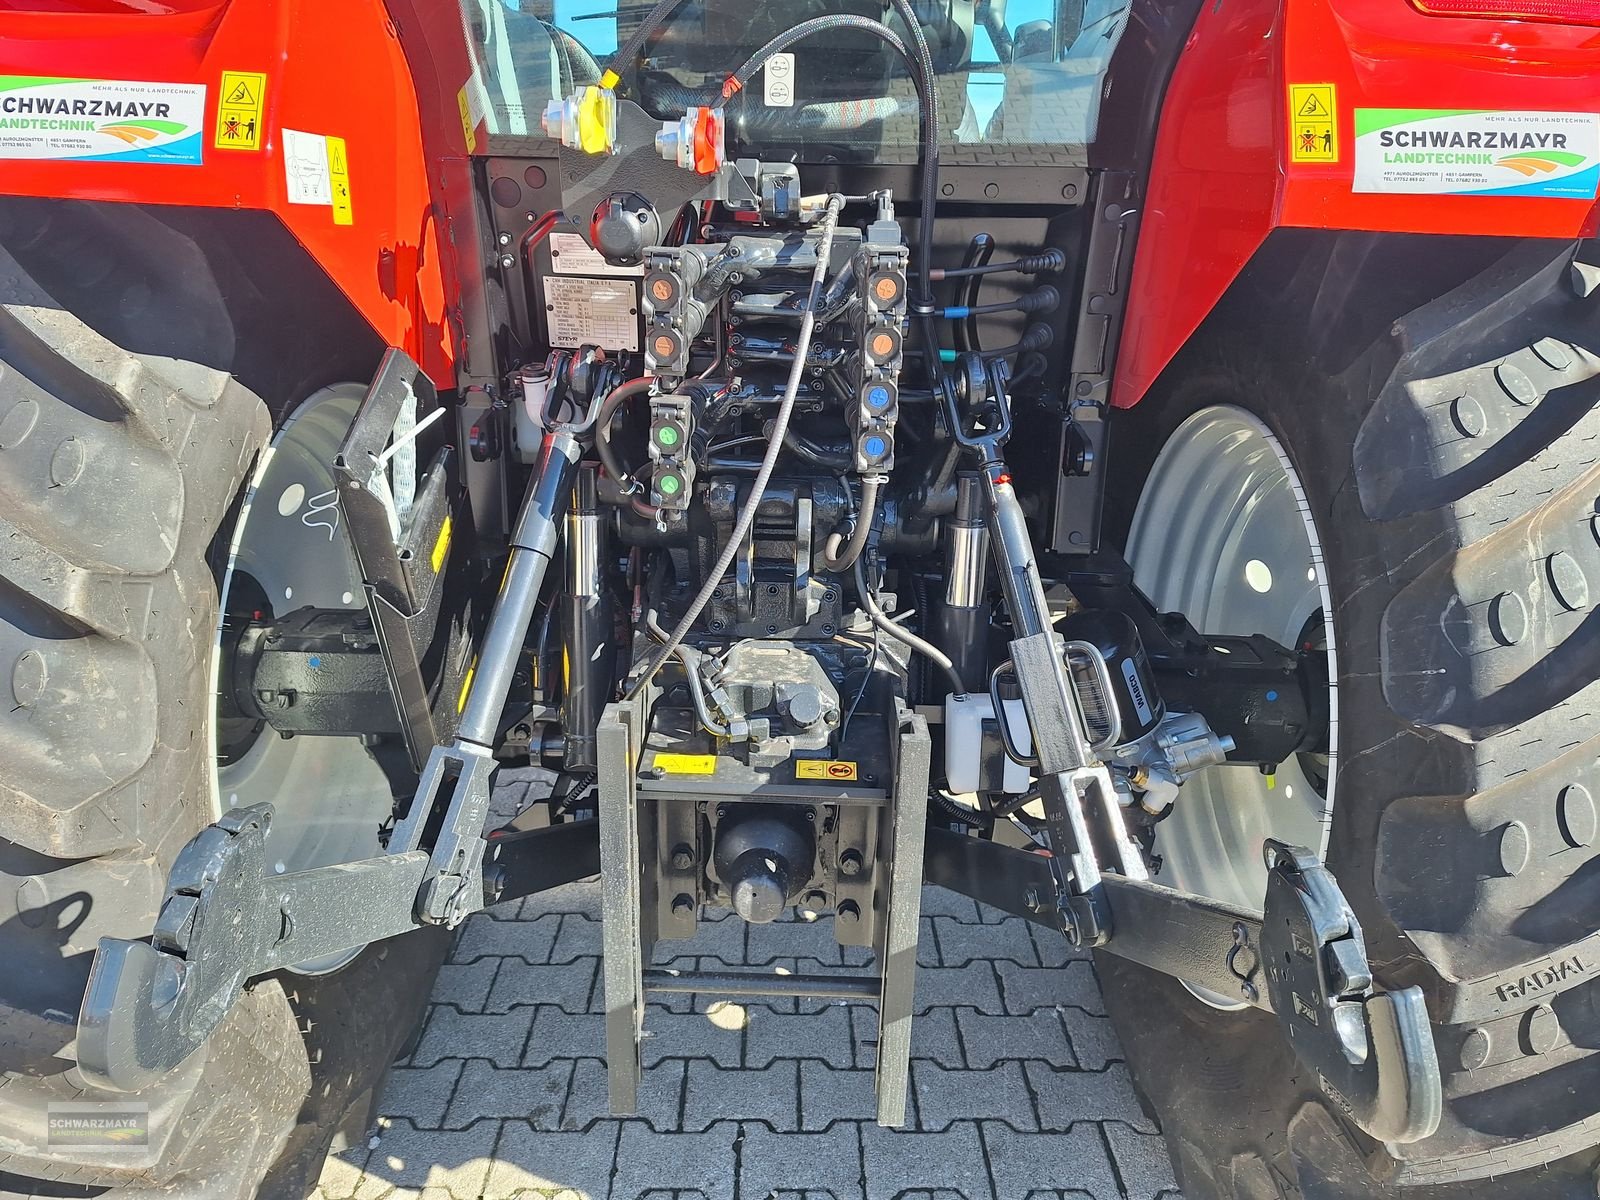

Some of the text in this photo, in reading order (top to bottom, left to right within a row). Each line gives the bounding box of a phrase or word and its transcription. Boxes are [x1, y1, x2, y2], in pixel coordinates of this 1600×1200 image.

[0, 97, 170, 118] CHWARZMAYR
[0, 118, 96, 131] ANDTECHNIK
[1380, 130, 1567, 149] SCHWARZMAYR
[1384, 152, 1493, 165] LANDTECHNIK
[1129, 674, 1145, 709] WABCO
[1495, 955, 1592, 1002] RADIAL
